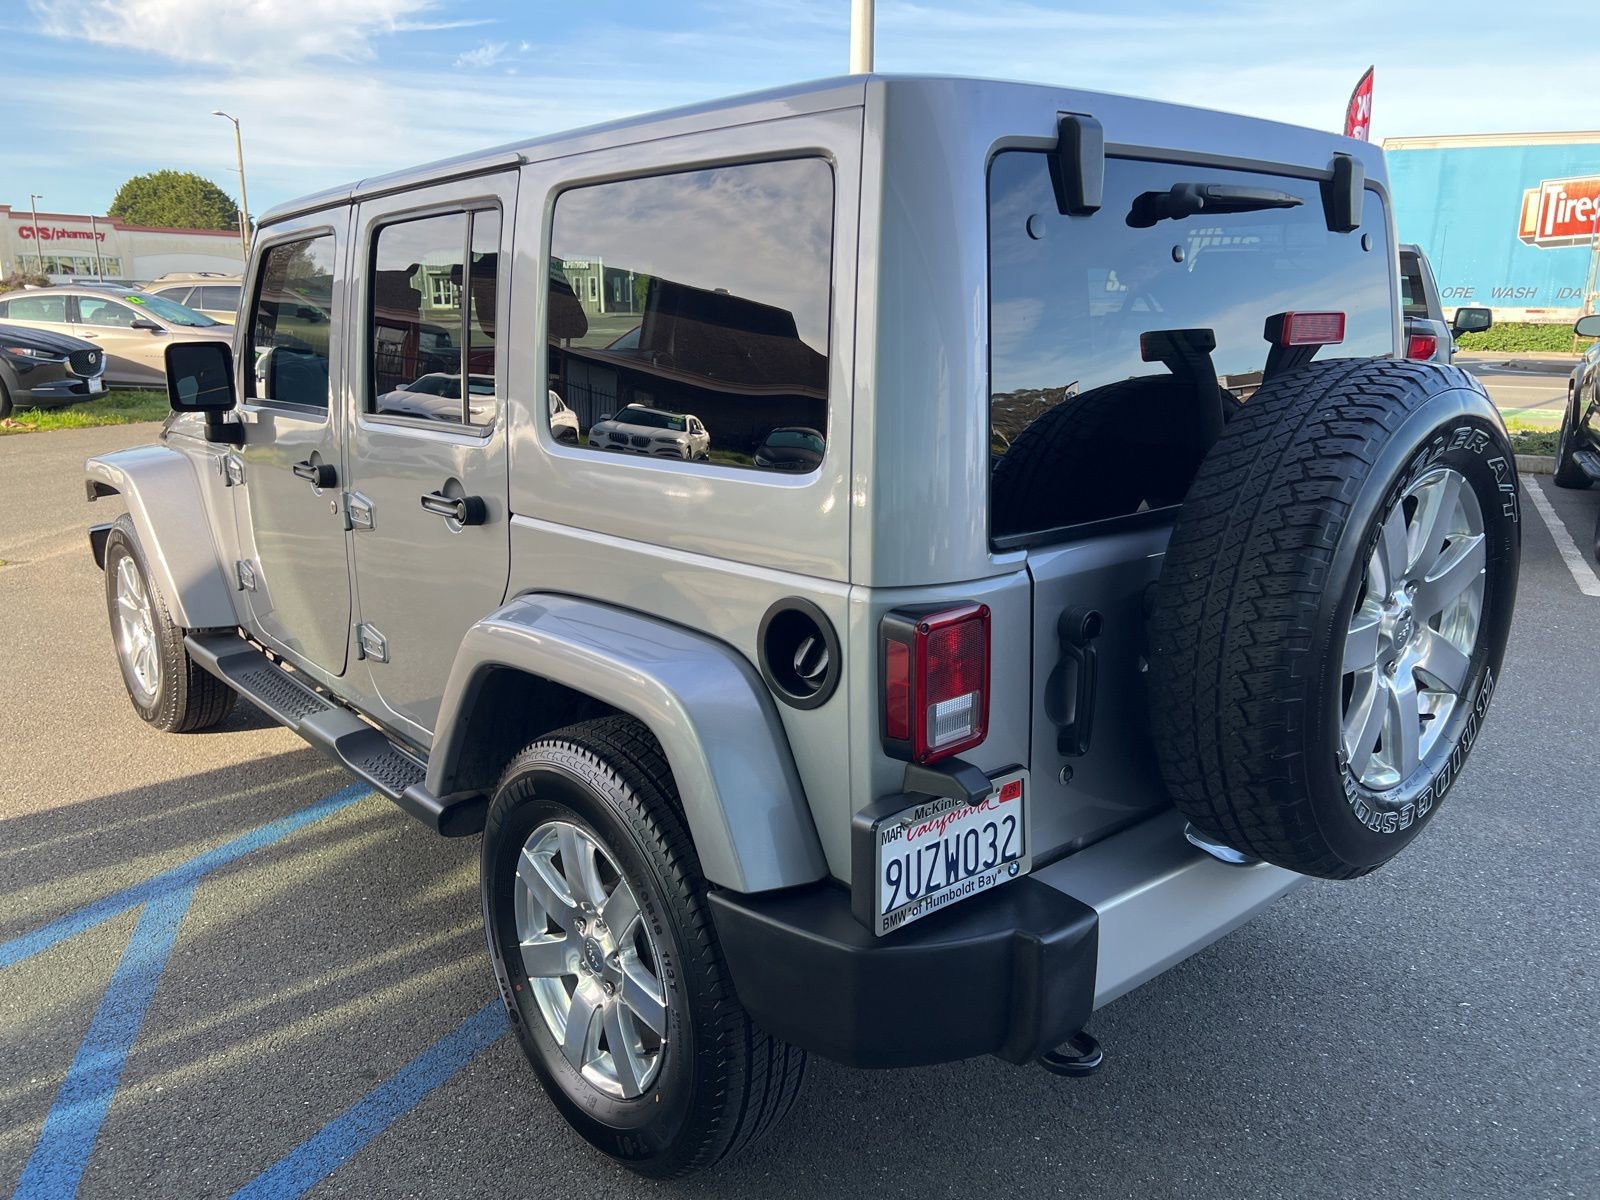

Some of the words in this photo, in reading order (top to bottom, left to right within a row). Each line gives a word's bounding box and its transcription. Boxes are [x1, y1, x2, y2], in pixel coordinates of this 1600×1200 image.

[1441, 287, 1475, 299] ORE
[1491, 287, 1537, 299] WASH
[1556, 287, 1582, 299] IDA
[1335, 668, 1494, 834] BRIDGESTONE
[882, 909, 907, 931] BMW
[912, 900, 922, 917] of
[925, 881, 975, 911] Humboldt
[978, 873, 997, 889] Bay
[885, 815, 1017, 912] 9UZW032
